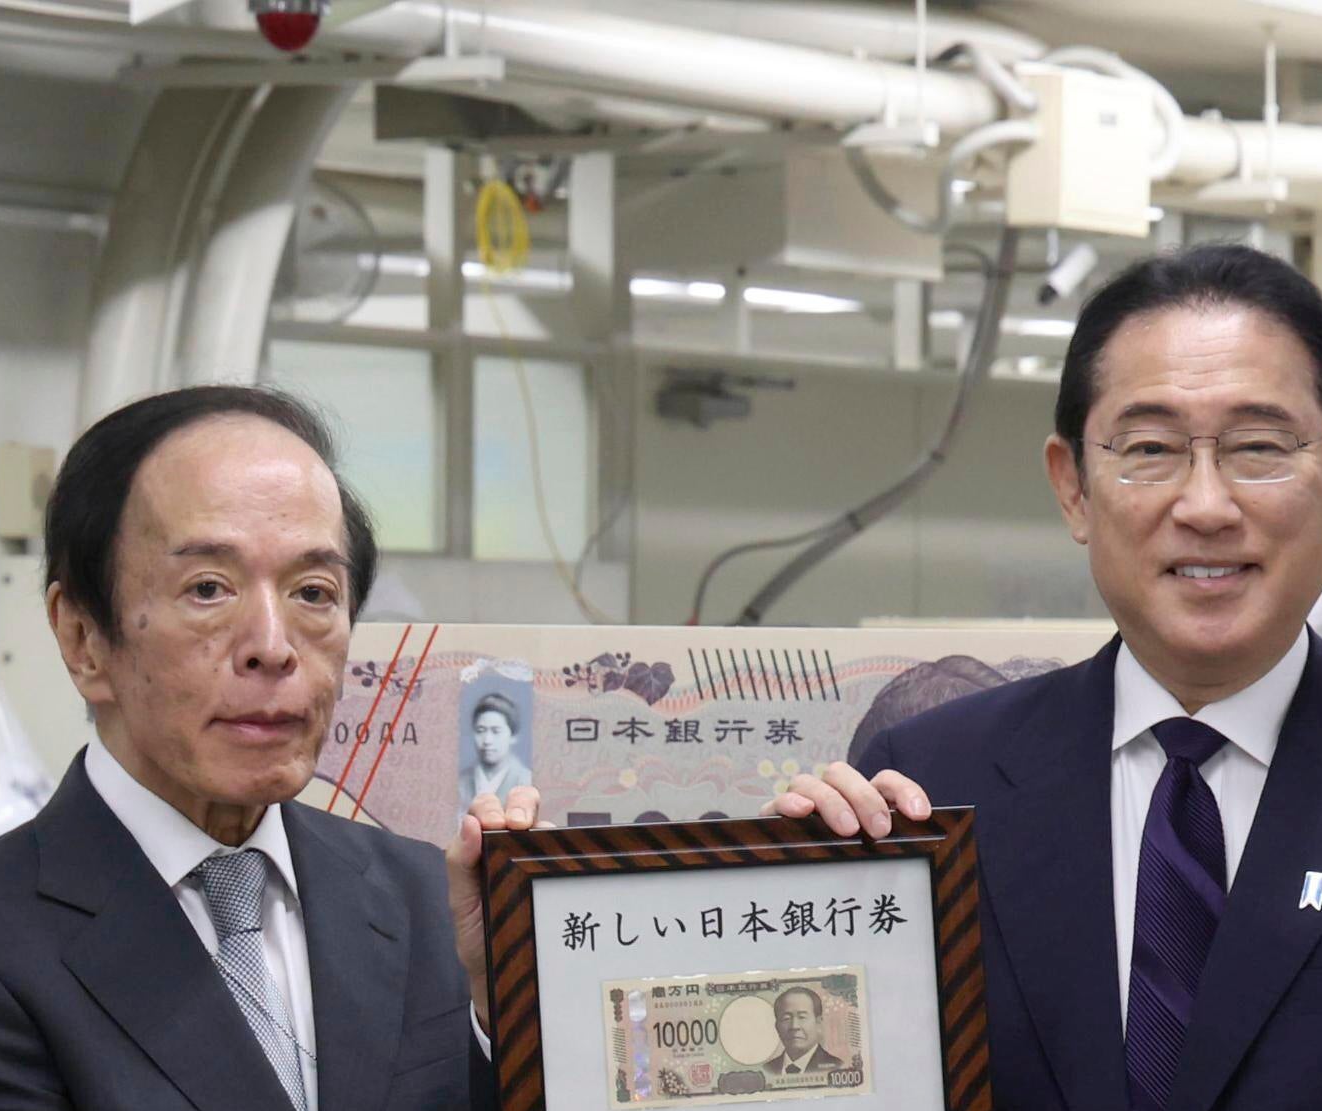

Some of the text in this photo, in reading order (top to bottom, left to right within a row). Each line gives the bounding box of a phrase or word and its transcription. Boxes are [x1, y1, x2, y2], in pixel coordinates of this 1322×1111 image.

[566, 716, 804, 746] 日本銀行券
[561, 893, 908, 952] 新しい日本銀行券
[652, 1018, 718, 1048] 10000
[830, 1070, 861, 1085] 10000
